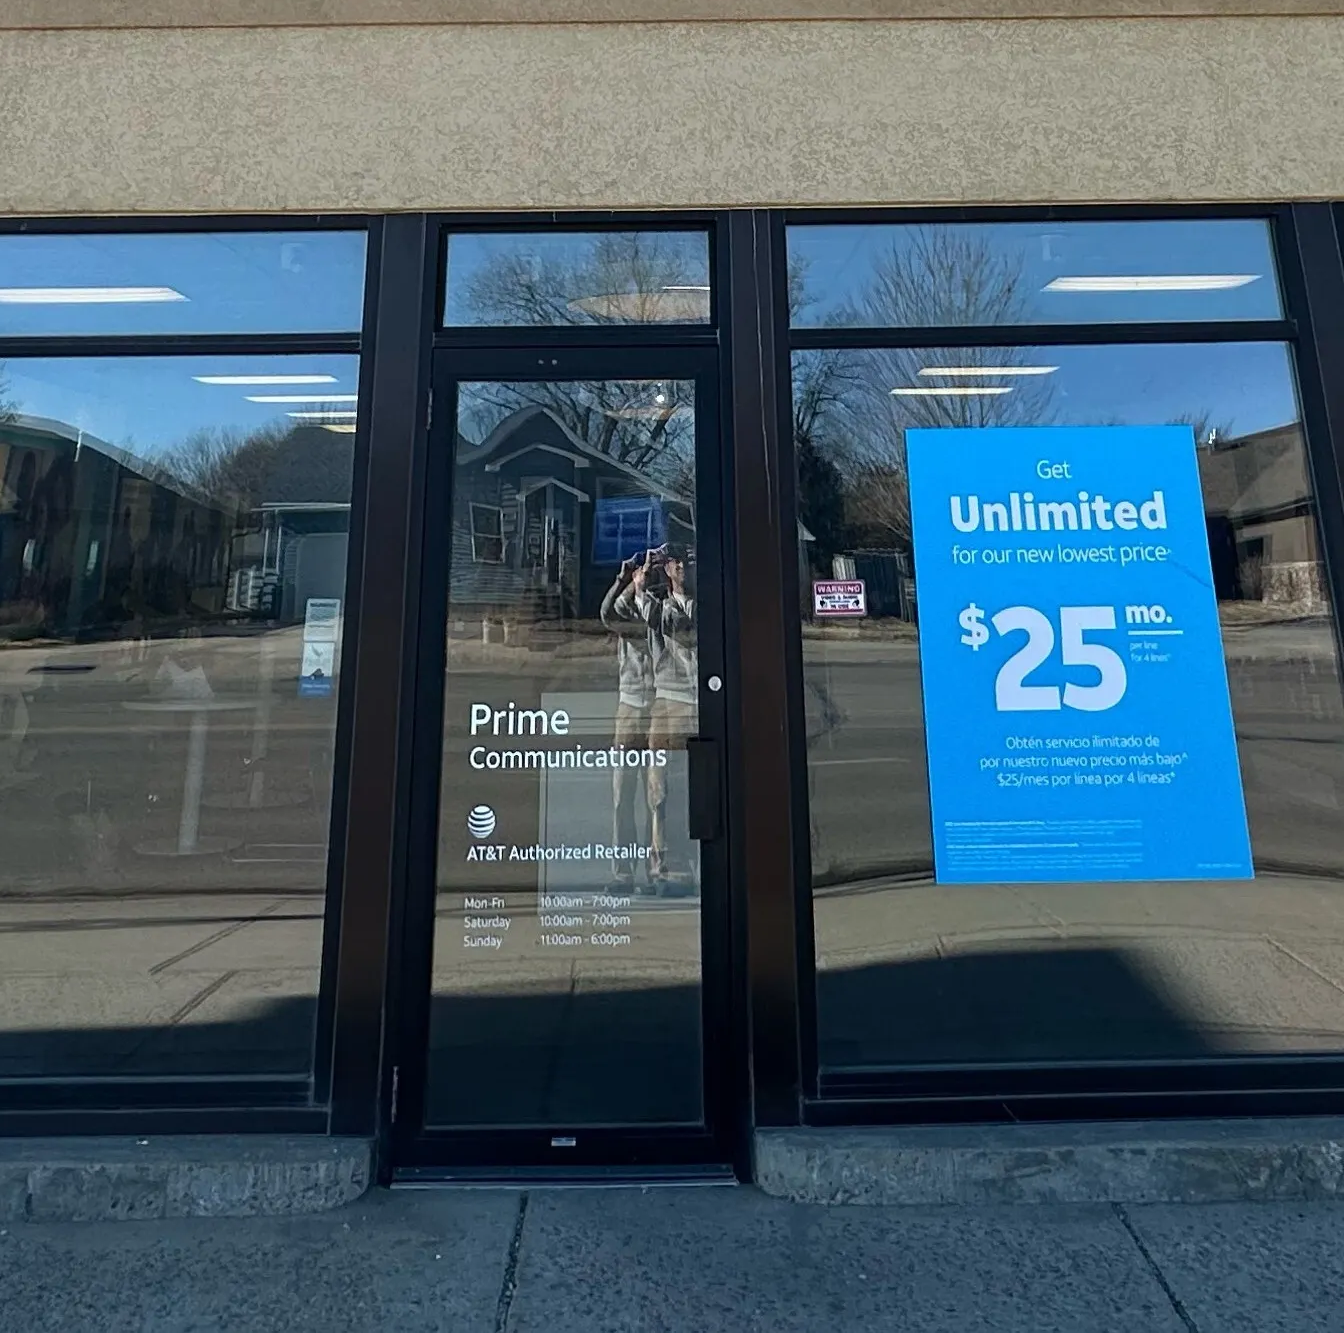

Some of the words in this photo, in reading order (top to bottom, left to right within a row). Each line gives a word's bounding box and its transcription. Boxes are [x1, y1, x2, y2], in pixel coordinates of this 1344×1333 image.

[1036, 459, 1072, 480] Get
[950, 490, 1168, 533] Unlimited
[952, 545, 978, 565] for
[982, 548, 1012, 564] our
[1017, 547, 1054, 563] new
[1057, 543, 1116, 563] lowest
[958, 602, 1128, 712] $25
[1125, 604, 1173, 624] mo.
[470, 703, 570, 735] Prime
[1006, 736, 1043, 750] Obtén
[1045, 738, 1089, 749] servicio
[1092, 734, 1142, 748] ilimitado
[1144, 734, 1160, 748] de
[469, 746, 667, 769] Communications
[980, 757, 1000, 771] por
[1003, 755, 1049, 768] nuestro
[1051, 756, 1088, 767] nuevo
[1090, 753, 1126, 768] precio
[1128, 752, 1154, 766] más
[997, 772, 1049, 787] $25/mes
[1051, 774, 1071, 787] por
[1104, 773, 1124, 787] por
[1127, 771, 1135, 784] 4
[467, 845, 506, 861] AT&T
[509, 844, 591, 861] Authorized
[595, 843, 652, 858] Retailer
[464, 897, 505, 909] Mon-Fri
[541, 896, 583, 907] 10:00am
[592, 895, 631, 908] 7:00pm
[464, 917, 512, 931] Saturday
[540, 916, 583, 927] 10:00am
[592, 914, 631, 928] 7:00pm
[463, 936, 503, 950] Sunday
[541, 935, 582, 945] 11:00am
[591, 933, 631, 947] 6:00pm
